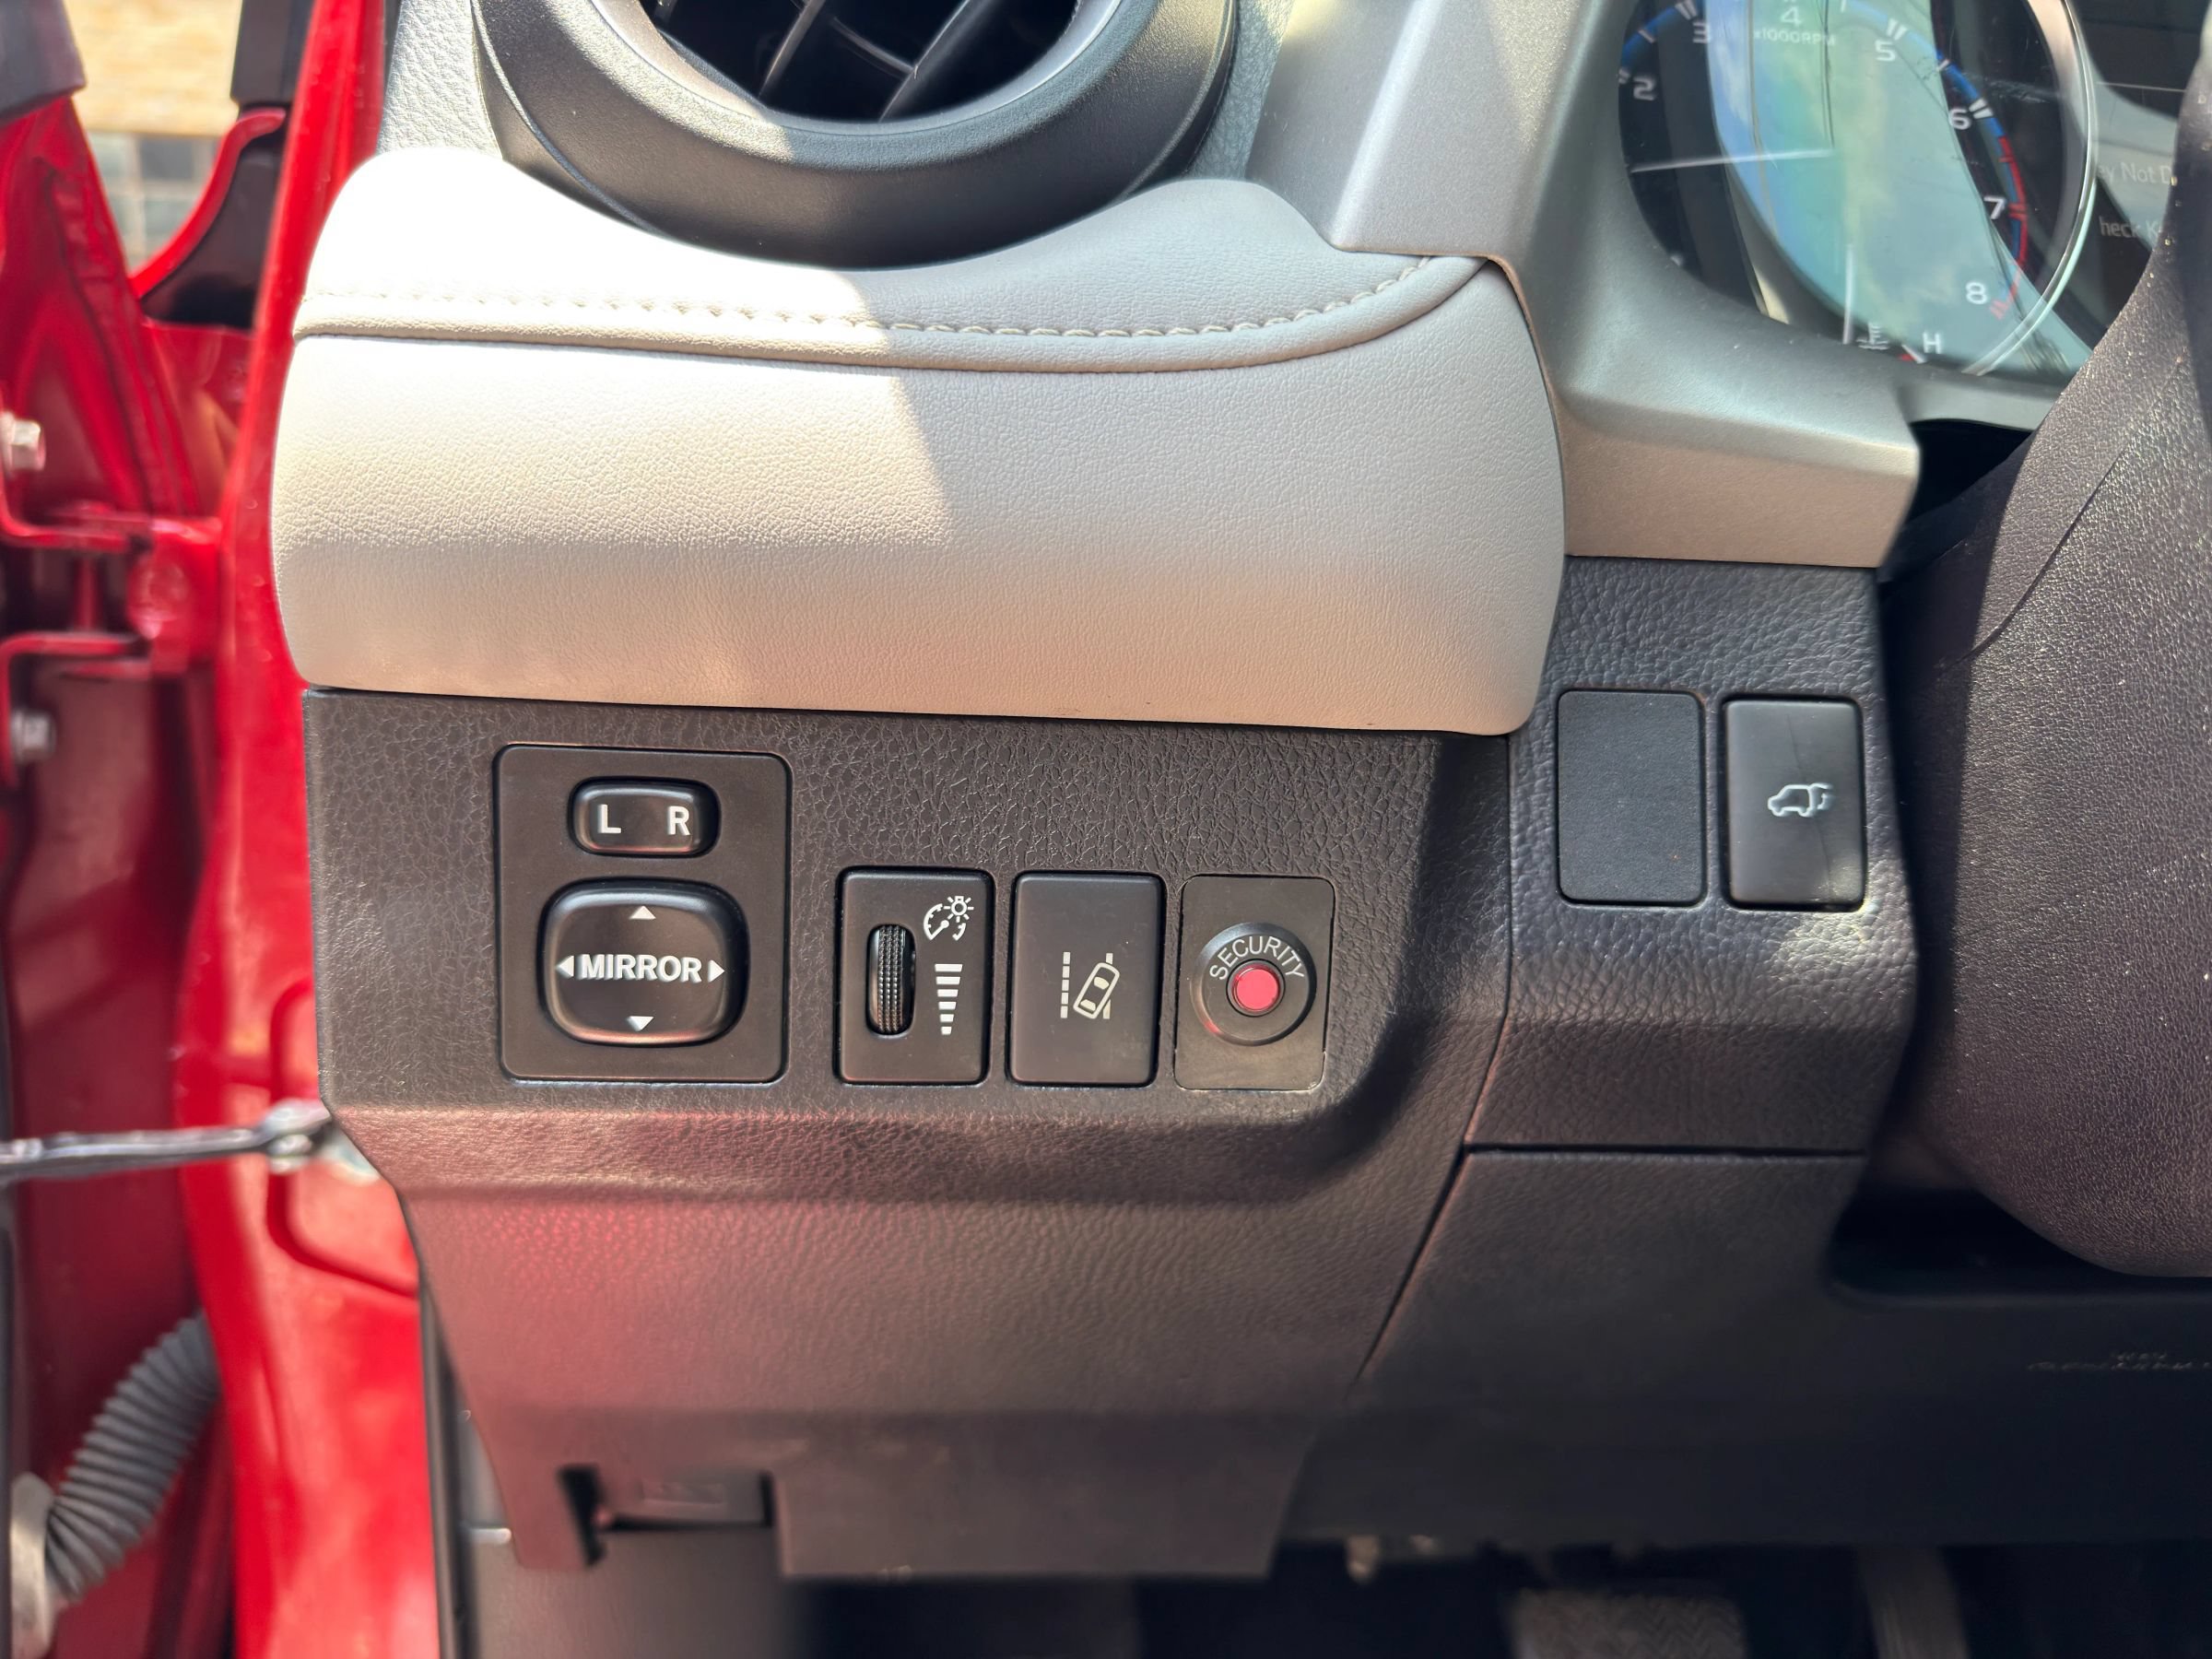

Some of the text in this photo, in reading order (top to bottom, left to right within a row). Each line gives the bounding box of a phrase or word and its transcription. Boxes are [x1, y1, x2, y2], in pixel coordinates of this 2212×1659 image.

[1781, 6, 1802, 26] 4
[1692, 20, 1712, 43] 3
[1875, 39, 1896, 61] 5
[1632, 76, 1656, 100] 2
[1948, 108, 1971, 130] 6
[2121, 162, 2156, 183] Not
[1983, 195, 2006, 219] 7
[1965, 282, 1987, 304] 8
[1923, 332, 1942, 354] H
[598, 804, 690, 836] L R
[577, 954, 702, 982] MIRROR
[1209, 935, 1305, 980] SECURITY
